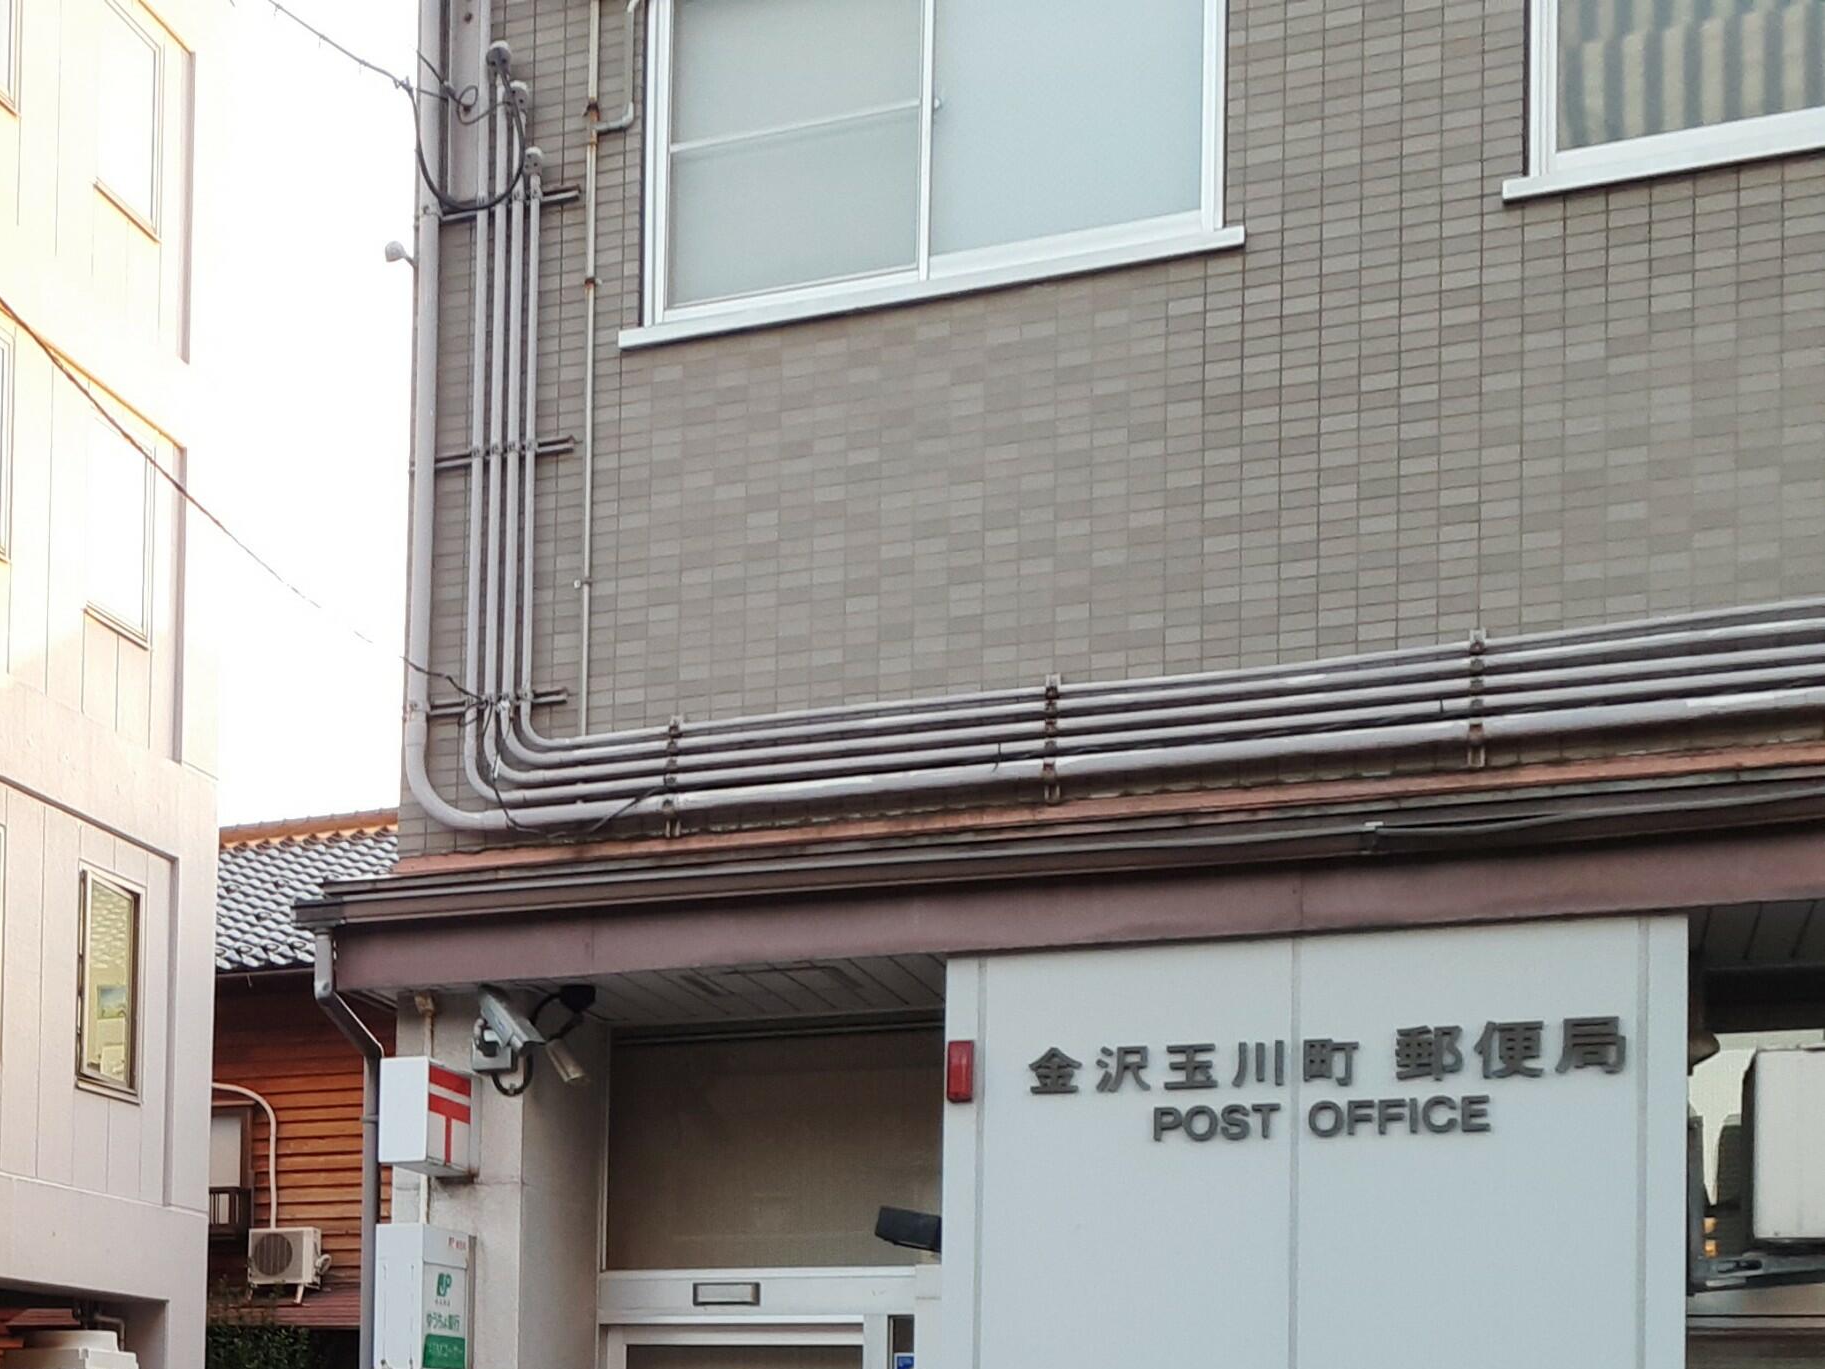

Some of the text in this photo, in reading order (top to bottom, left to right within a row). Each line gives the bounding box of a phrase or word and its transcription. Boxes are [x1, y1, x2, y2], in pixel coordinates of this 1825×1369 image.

[1028, 1014, 1627, 1095] 金沢玉川町 郵便局
[1152, 1095, 1491, 1143] POST OFFICE
